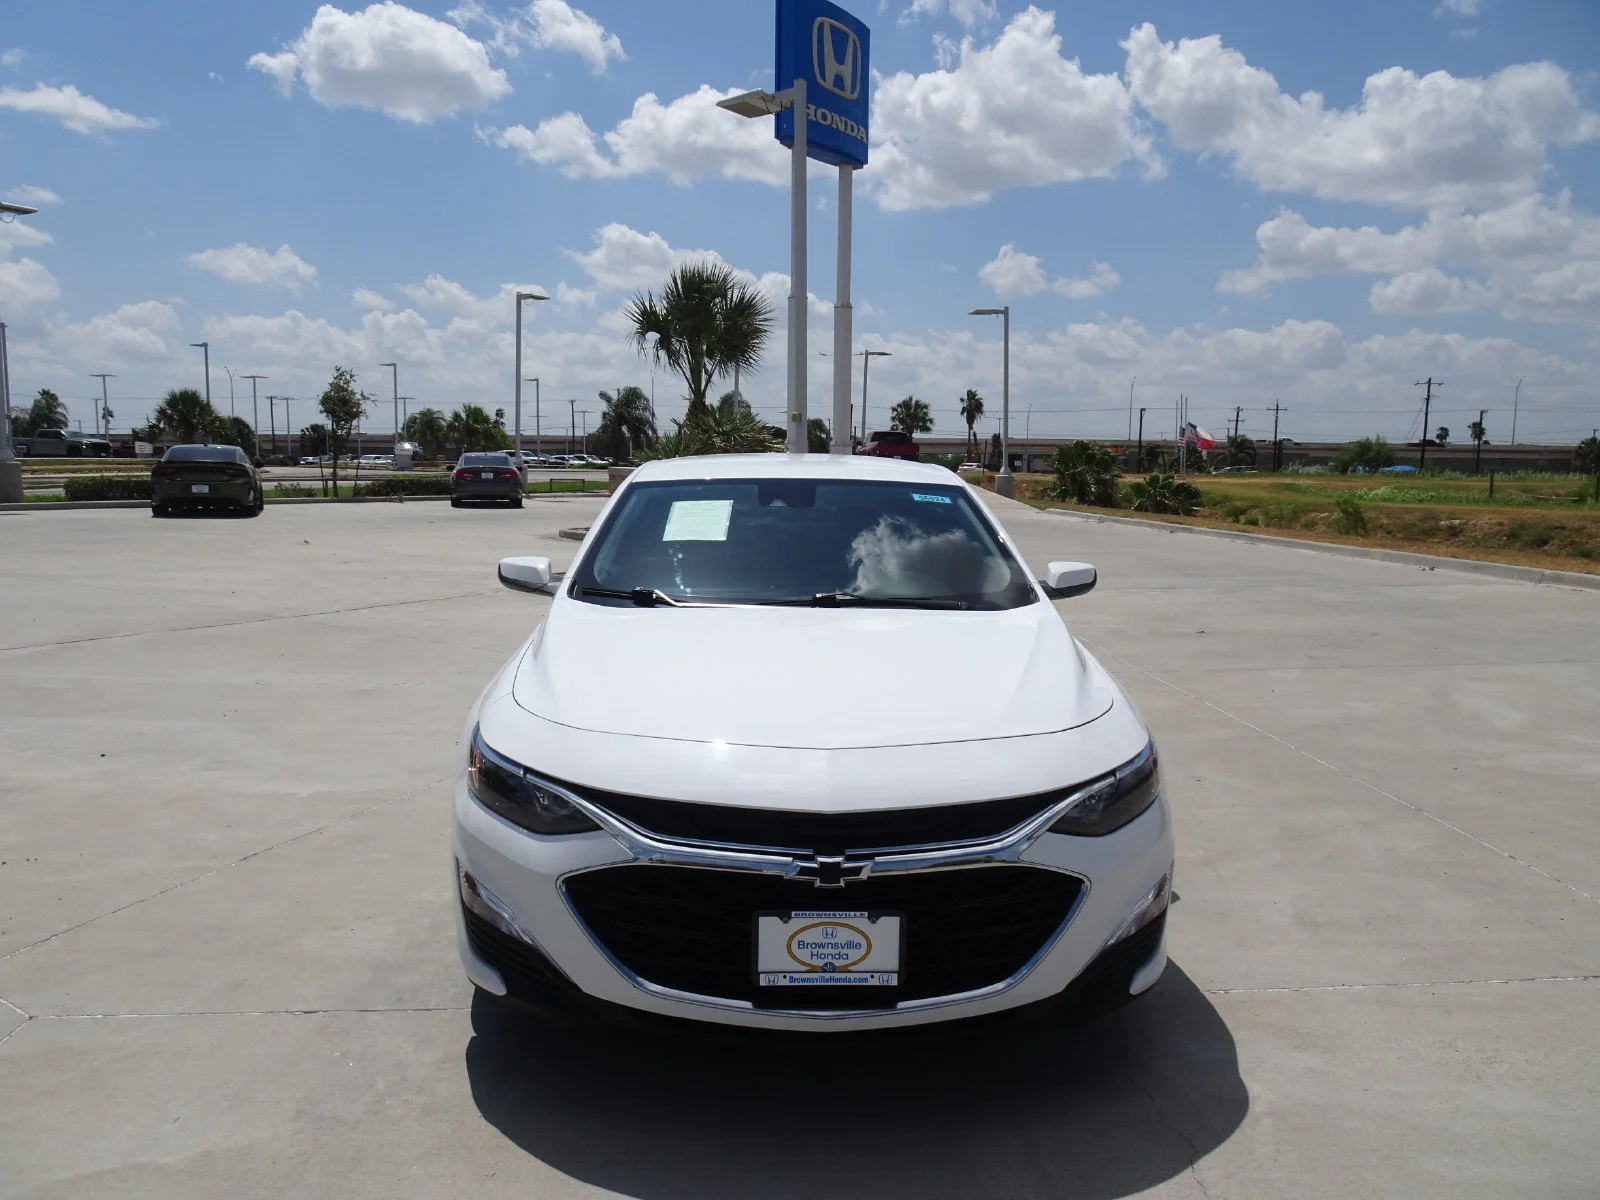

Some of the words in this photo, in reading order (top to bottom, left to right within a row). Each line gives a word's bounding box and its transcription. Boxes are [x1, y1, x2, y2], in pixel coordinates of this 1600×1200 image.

[807, 104, 867, 145] HONDA
[797, 940, 862, 950] Brownsville
[810, 951, 849, 960] Honda
[788, 975, 869, 984] BrownsvilleHonda.com
